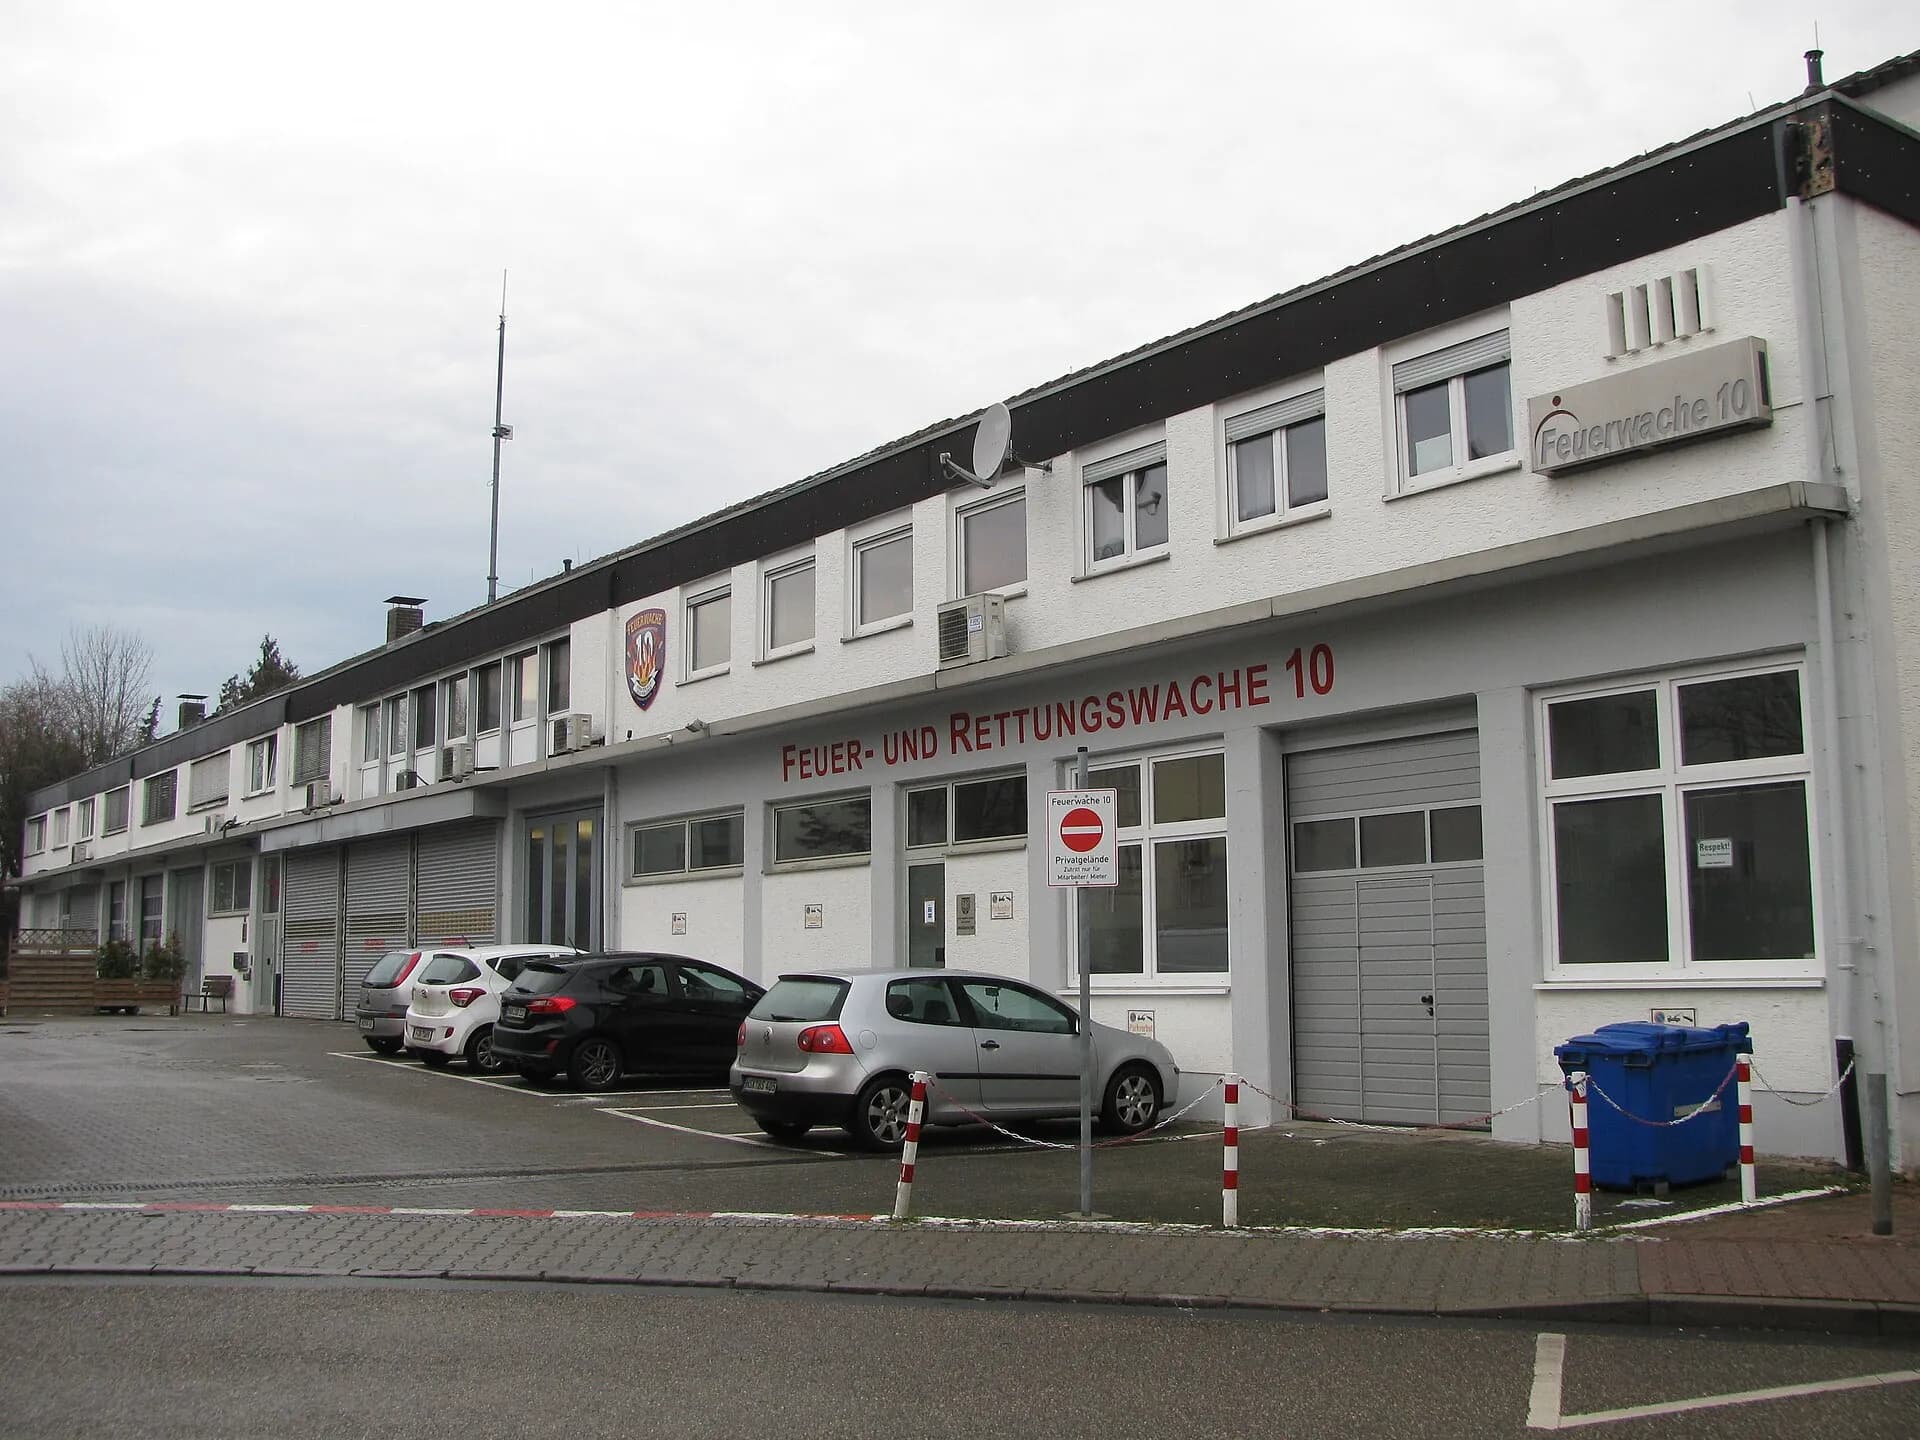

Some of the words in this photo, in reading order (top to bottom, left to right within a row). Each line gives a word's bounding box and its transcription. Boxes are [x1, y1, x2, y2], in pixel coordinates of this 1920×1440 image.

[1539, 395, 1709, 465] Feuerwache
[1715, 377, 1748, 420] 10
[782, 739, 875, 783] FEUER-
[883, 726, 939, 766] UND
[950, 665, 1270, 755] RETTUNGSWACHE
[1285, 643, 1335, 700] 10
[1052, 797, 1100, 806] Feuerwache
[1103, 796, 1111, 804] 10
